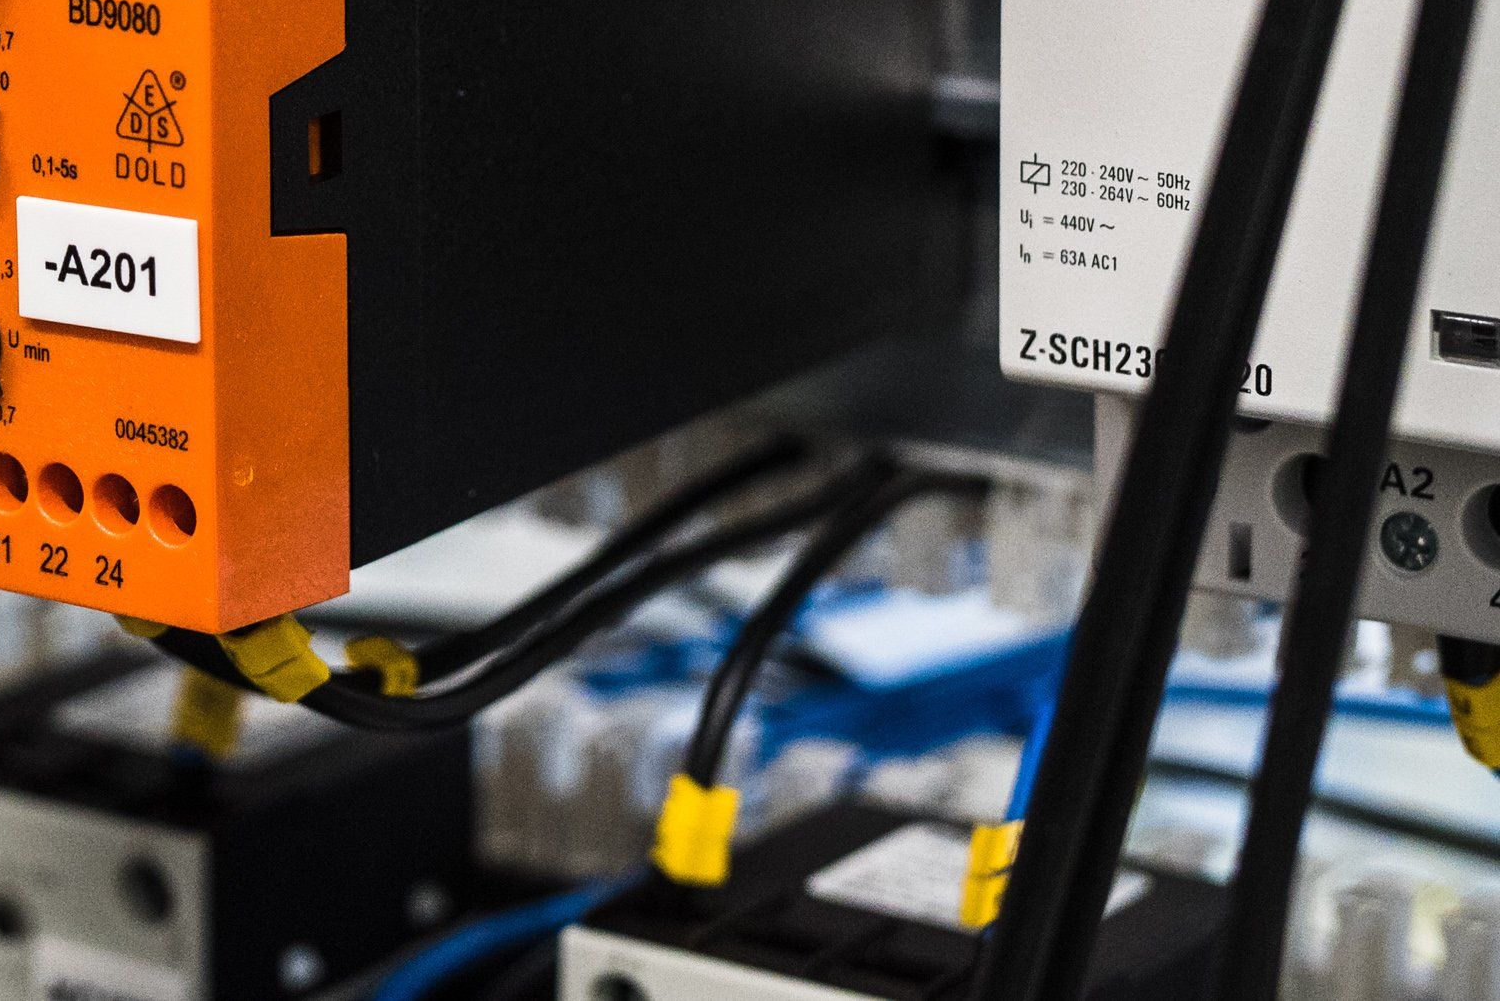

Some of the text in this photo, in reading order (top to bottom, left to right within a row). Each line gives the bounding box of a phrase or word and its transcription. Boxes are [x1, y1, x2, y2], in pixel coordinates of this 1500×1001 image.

[31, 153, 78, 181] 0,1-5s
[115, 152, 186, 189] DOLD
[1157, 172, 1191, 191] 50Hz
[1157, 192, 1191, 212] 60Hz
[1060, 214, 1095, 233] 440V
[44, 244, 157, 297] -A201
[1060, 249, 1086, 267] 63A
[1091, 254, 1117, 271] AC1
[114, 417, 189, 452] 0045382
[1379, 463, 1434, 499] A2
[39, 542, 69, 577] 22
[94, 554, 124, 589] 24
